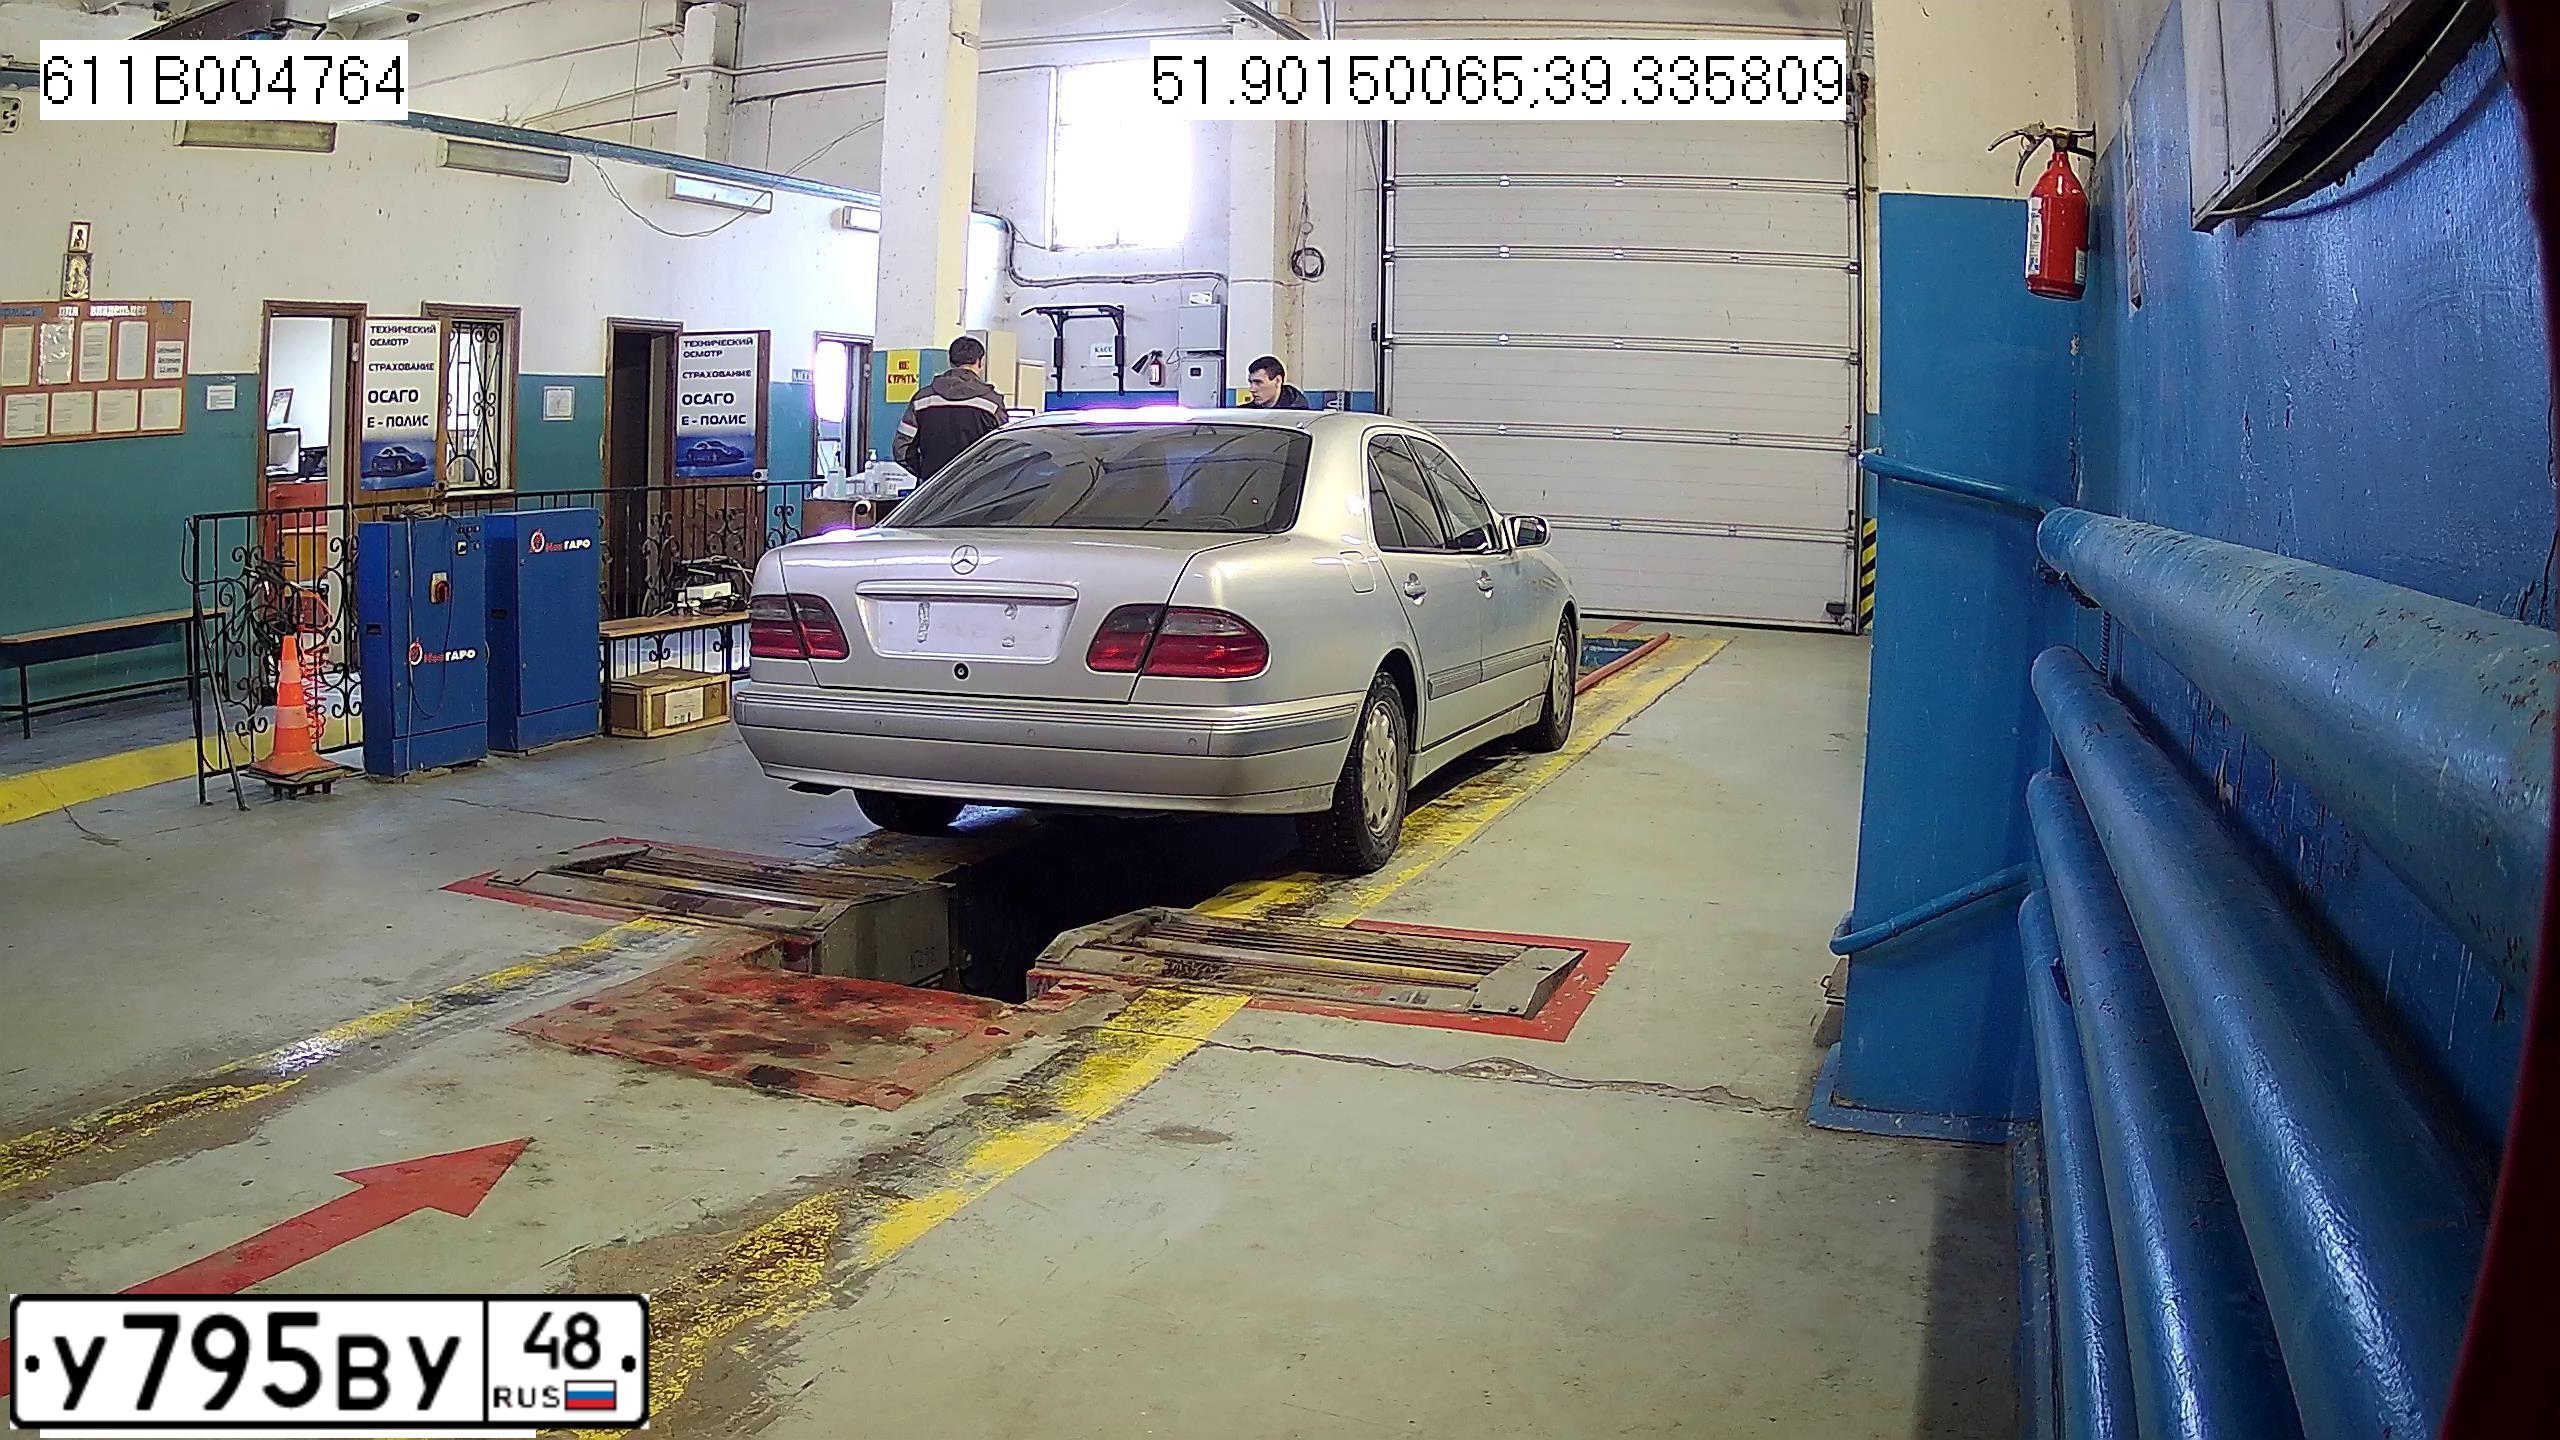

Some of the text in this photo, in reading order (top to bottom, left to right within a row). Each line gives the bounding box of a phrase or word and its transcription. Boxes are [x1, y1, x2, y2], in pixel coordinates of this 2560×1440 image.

[370, 325, 437, 334] ТЕХНИЧЕСКИЙ
[369, 338, 409, 346] ОСМОТР
[683, 338, 753, 347] ТЕХНИЧЕСКИЙ
[683, 350, 723, 358] ОСМОТР
[368, 363, 435, 371] СТРАХОВАНИЕ
[682, 370, 752, 378] СТРАХОВАНИЕ
[368, 389, 419, 404] ОСАГО
[681, 392, 735, 405] ОСАГО
[386, 415, 429, 427] ПОЛИС
[700, 414, 747, 426] ПОЛИС
